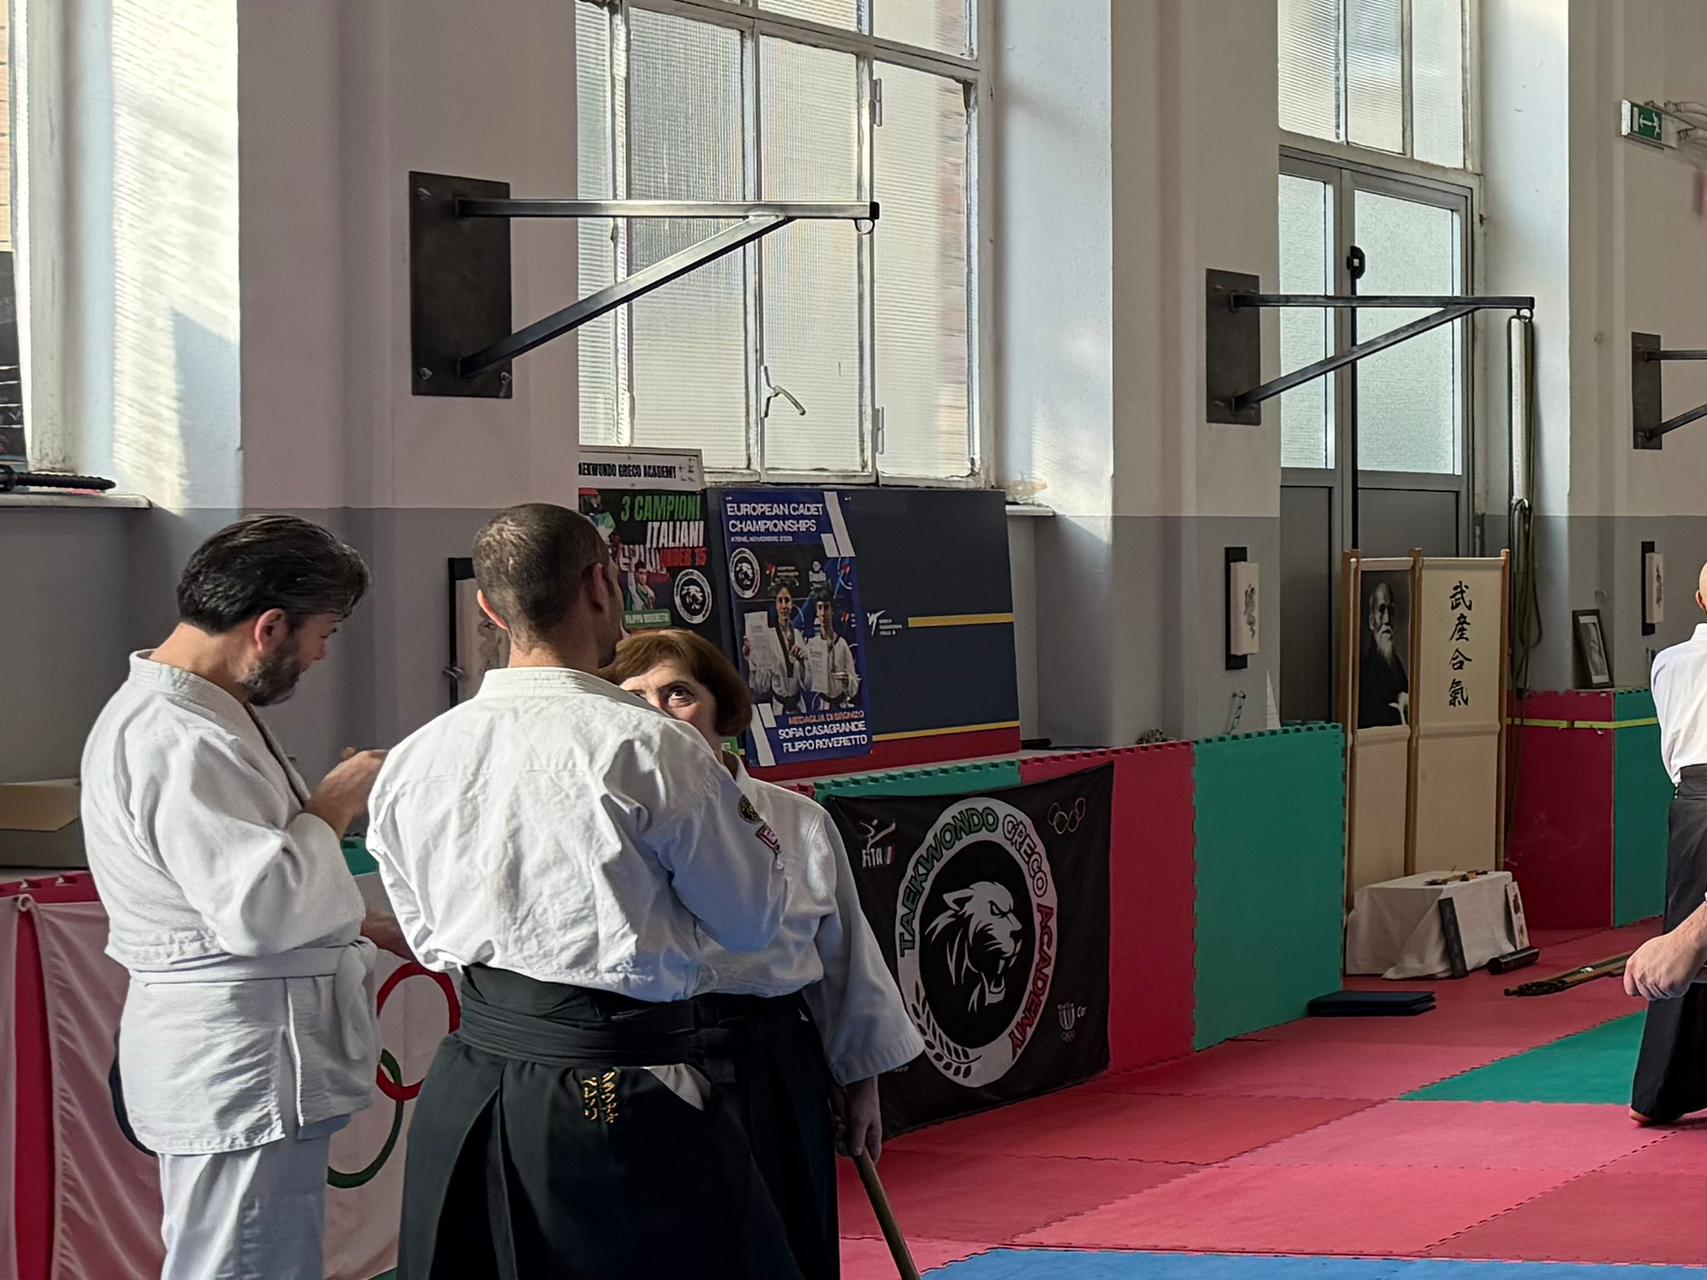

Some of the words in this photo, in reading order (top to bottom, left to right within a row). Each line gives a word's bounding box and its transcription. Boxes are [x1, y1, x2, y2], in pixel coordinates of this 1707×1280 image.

[621, 495, 632, 521] 3
[634, 495, 701, 521] CAMPIONI
[726, 503, 789, 516] EUROPEAN
[790, 503, 824, 516] CADET
[646, 521, 704, 548] ITALIANI
[729, 519, 817, 532] CHAMPIONSHIPS
[778, 728, 804, 740] SOFIA
[805, 720, 867, 737] CASAGRANDE
[783, 740, 815, 753] FILIPPO
[816, 734, 868, 750] ROVERETTO
[1003, 813, 1048, 899] GRECO
[899, 807, 999, 958] TAEKWONDO
[1009, 903, 1055, 1061] ACADEMY
